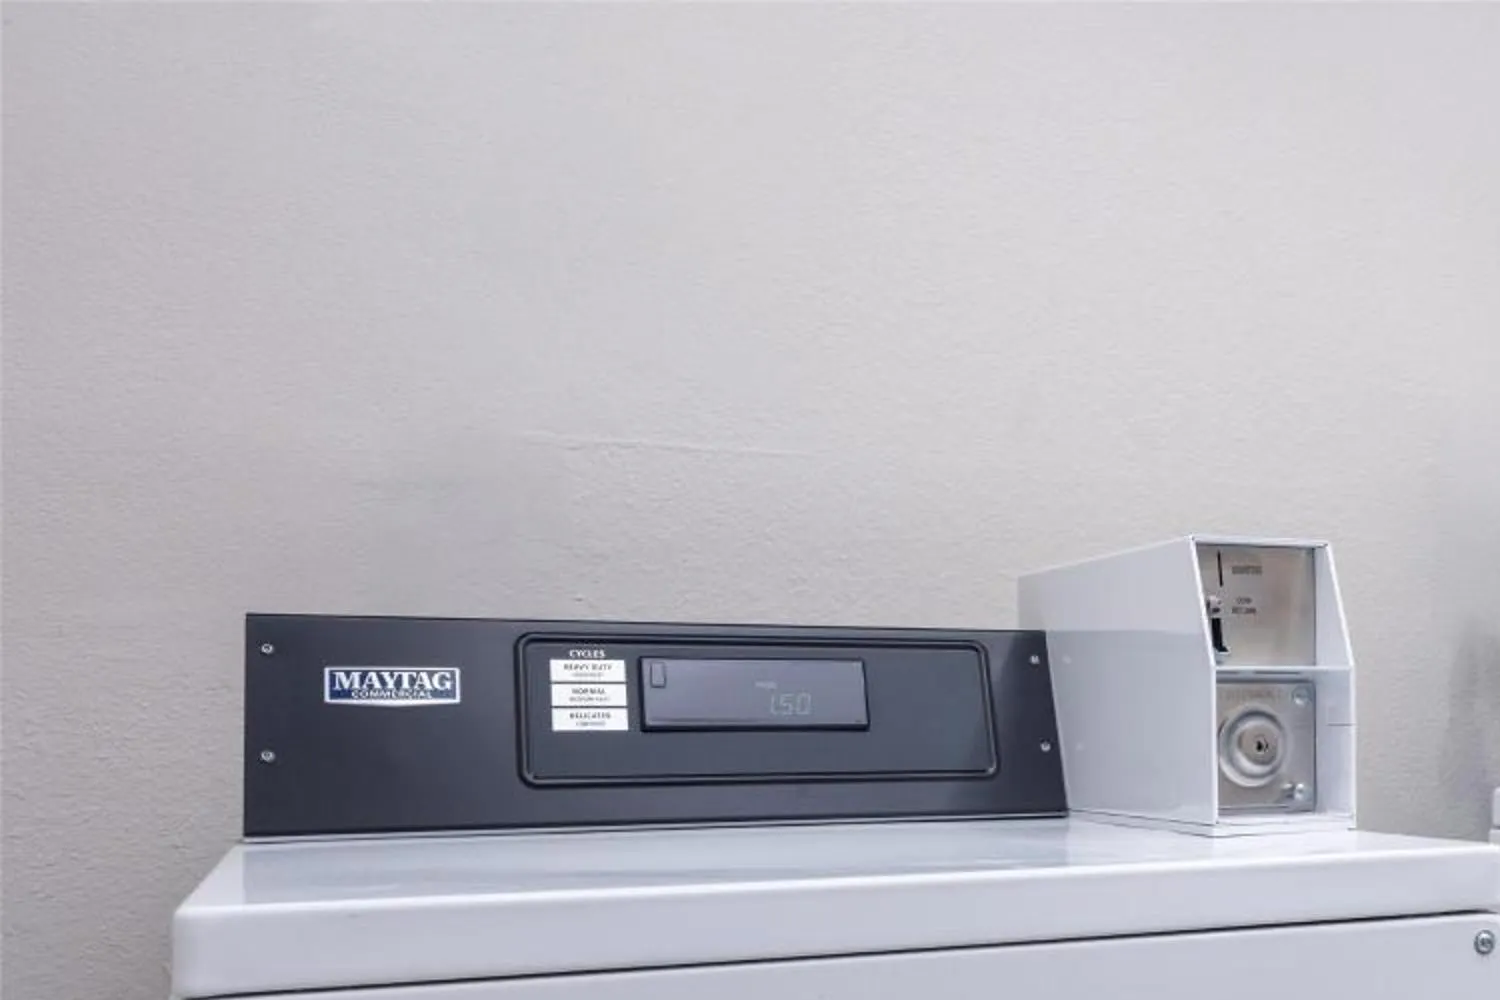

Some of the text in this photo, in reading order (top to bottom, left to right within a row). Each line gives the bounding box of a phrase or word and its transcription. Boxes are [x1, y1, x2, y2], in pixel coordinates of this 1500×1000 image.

[569, 649, 606, 658] CYCLES
[333, 671, 451, 690] MAYTAG
[351, 688, 433, 699] COMMERCIAL
